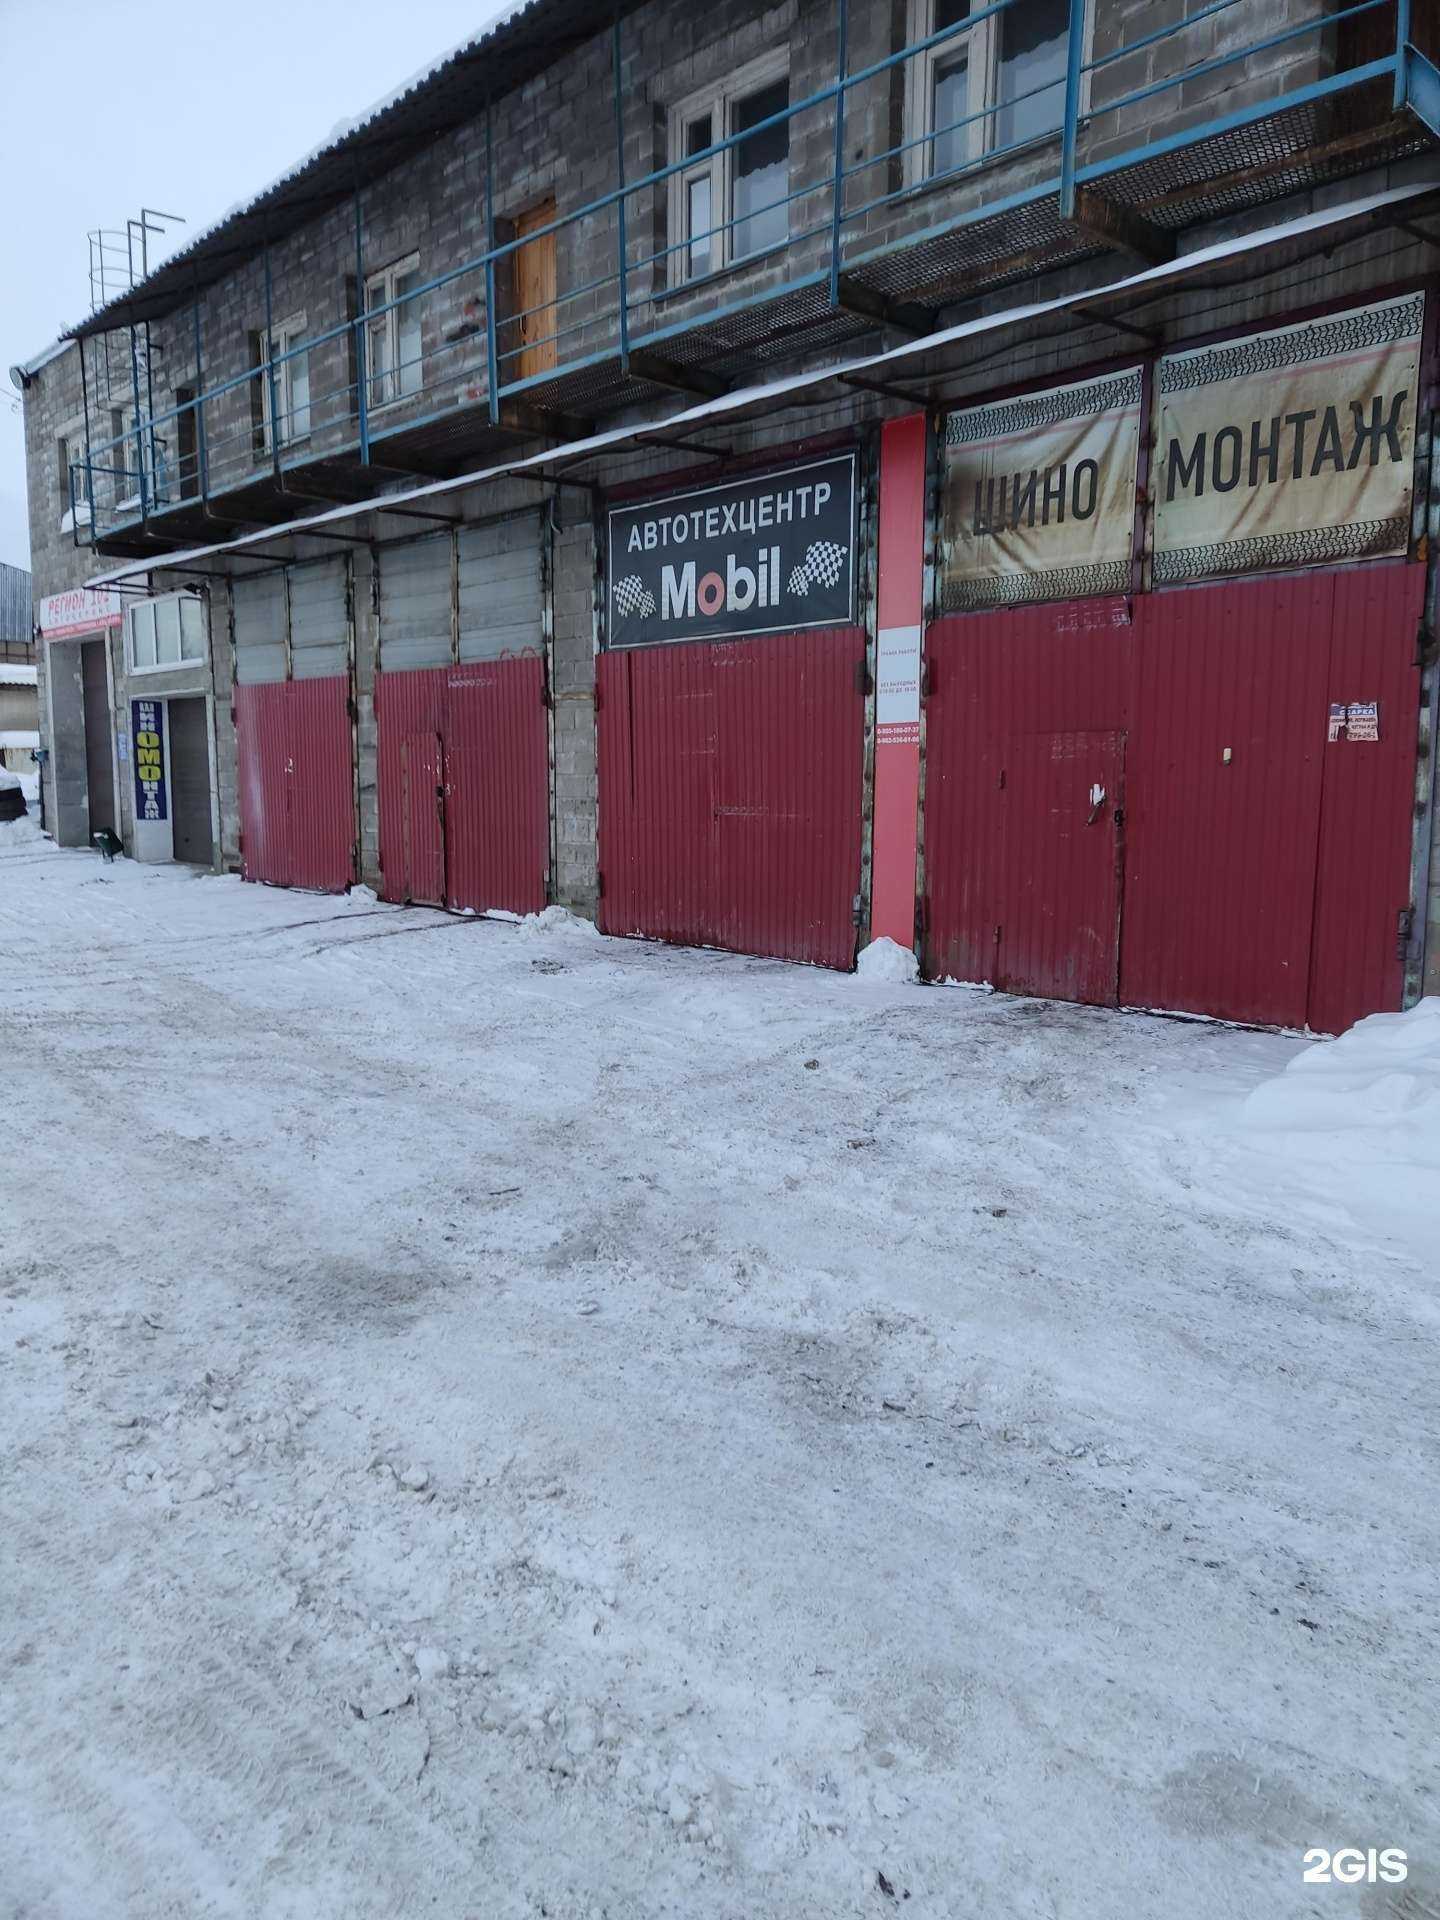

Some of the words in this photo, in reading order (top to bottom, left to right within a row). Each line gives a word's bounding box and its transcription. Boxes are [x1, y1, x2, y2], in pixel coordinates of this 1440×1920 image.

[972, 458, 1099, 537] ШИНО
[1166, 390, 1409, 501] МОНТАЖ
[627, 482, 832, 552] АВТОТЕХЦЕНТР
[48, 590, 86, 615] РЕГИОН
[661, 546, 780, 621] Mobil
[137, 702, 161, 819] ШИНОМОНТАЖ
